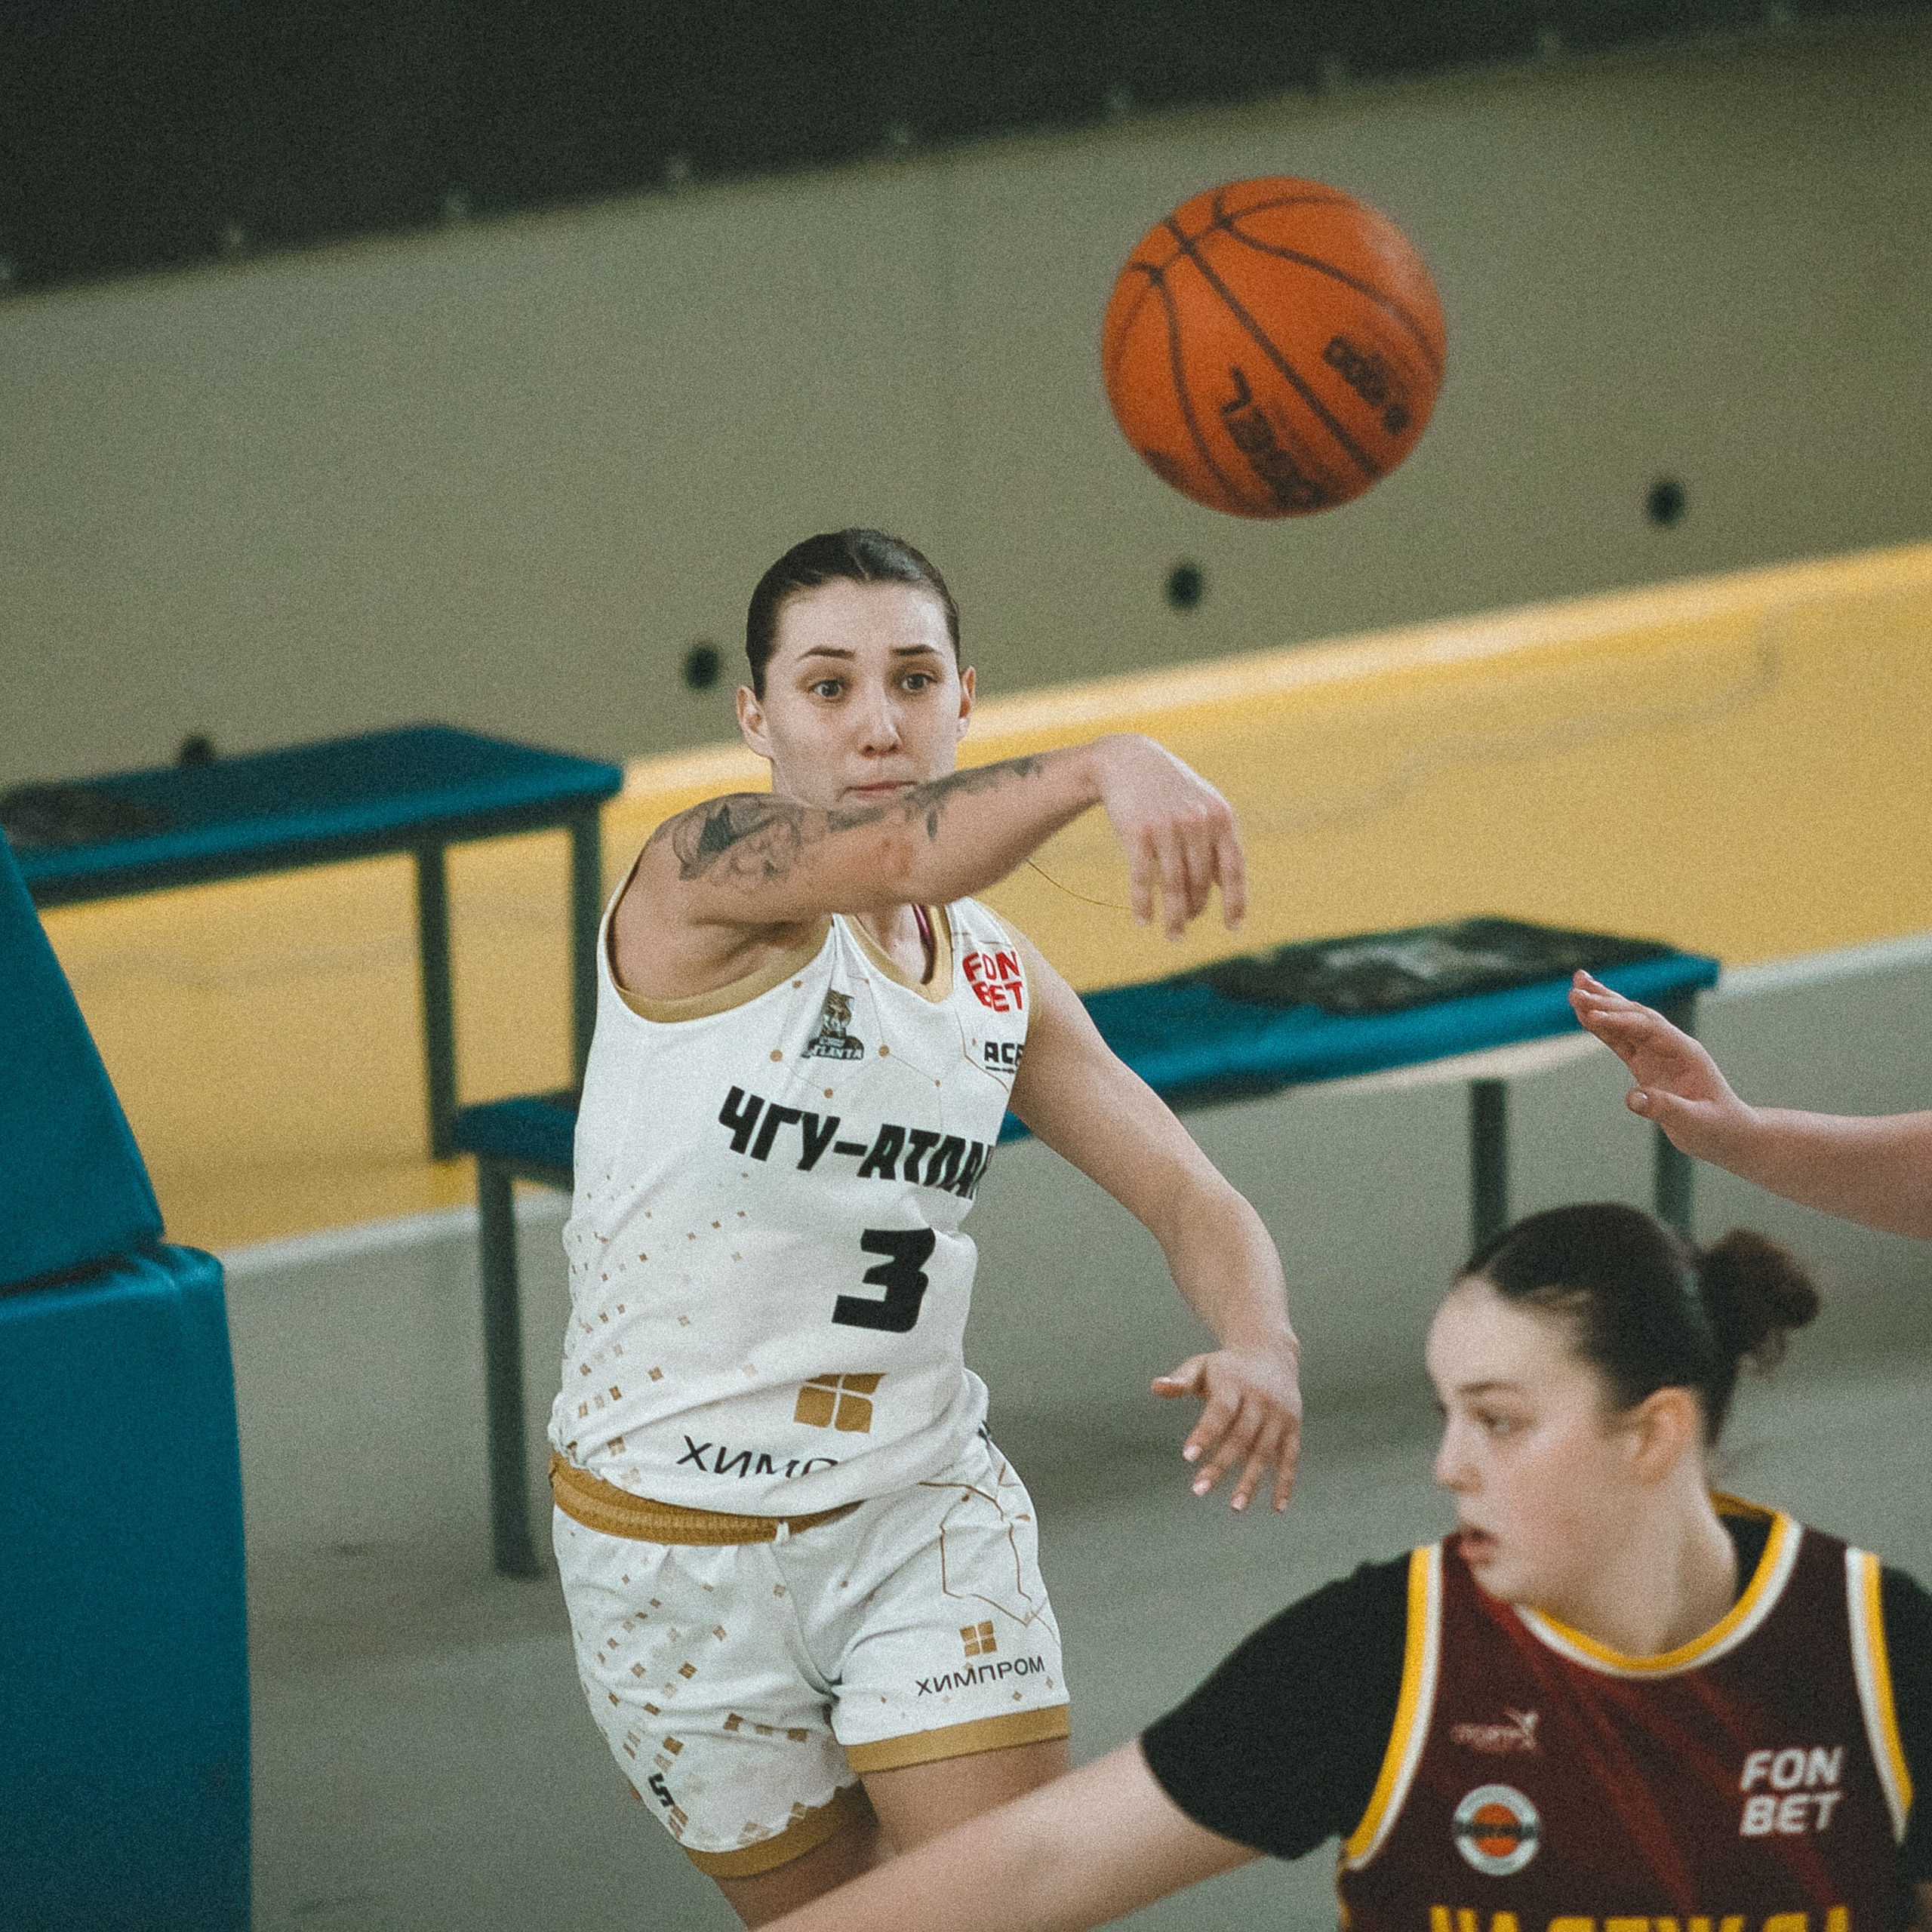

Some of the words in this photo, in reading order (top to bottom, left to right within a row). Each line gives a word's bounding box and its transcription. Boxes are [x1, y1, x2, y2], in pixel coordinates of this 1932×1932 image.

[962, 952, 1020, 982] FON
[972, 981, 1023, 1012] BET
[832, 1227, 936, 1334] 3
[915, 1656, 1045, 1697] ХИМПРОМ
[1740, 1746, 1844, 1791] FON
[1740, 1791, 1844, 1836] BET
